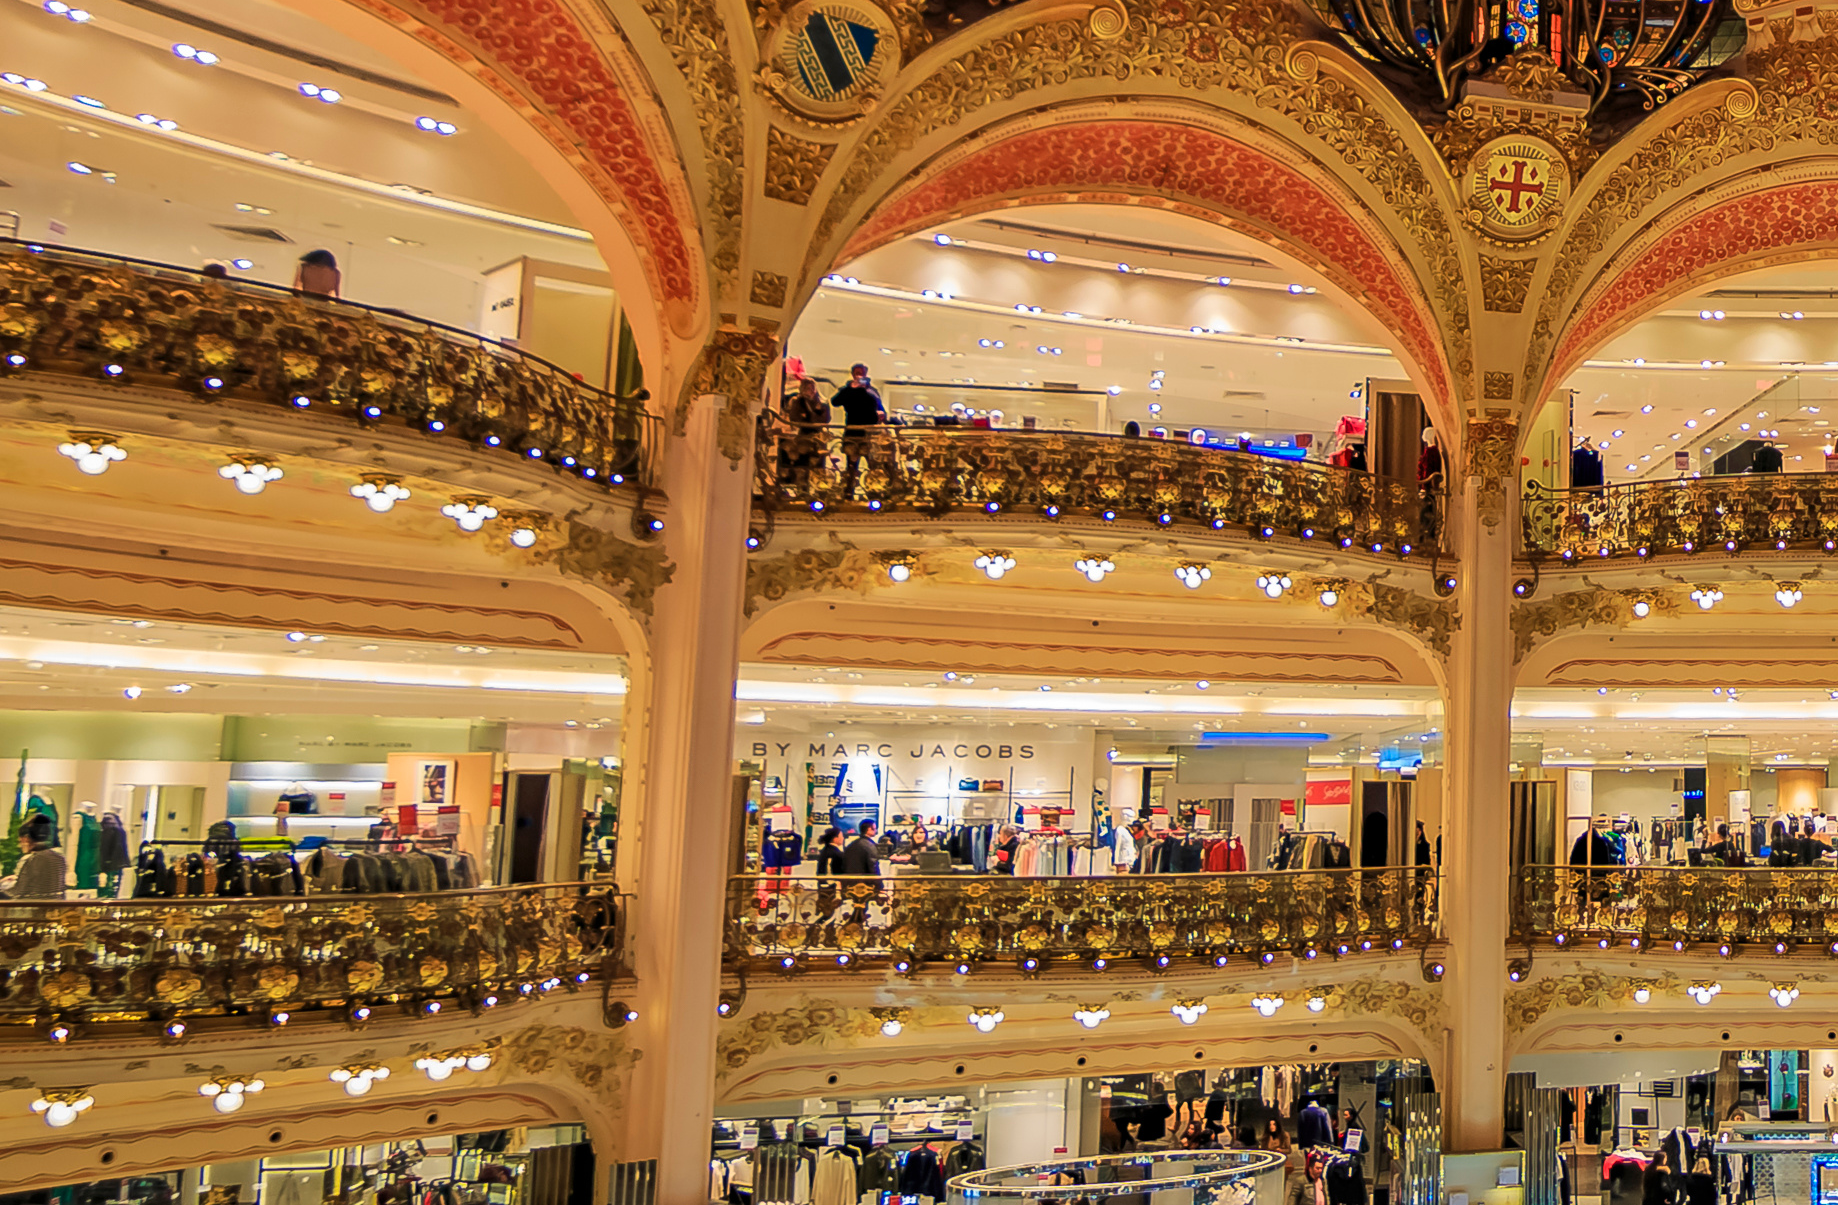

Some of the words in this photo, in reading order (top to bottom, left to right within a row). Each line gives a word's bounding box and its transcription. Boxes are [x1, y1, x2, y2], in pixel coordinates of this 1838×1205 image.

[752, 742, 790, 756] BY
[809, 743, 892, 757] MARC
[911, 744, 1034, 758] JACOBS
